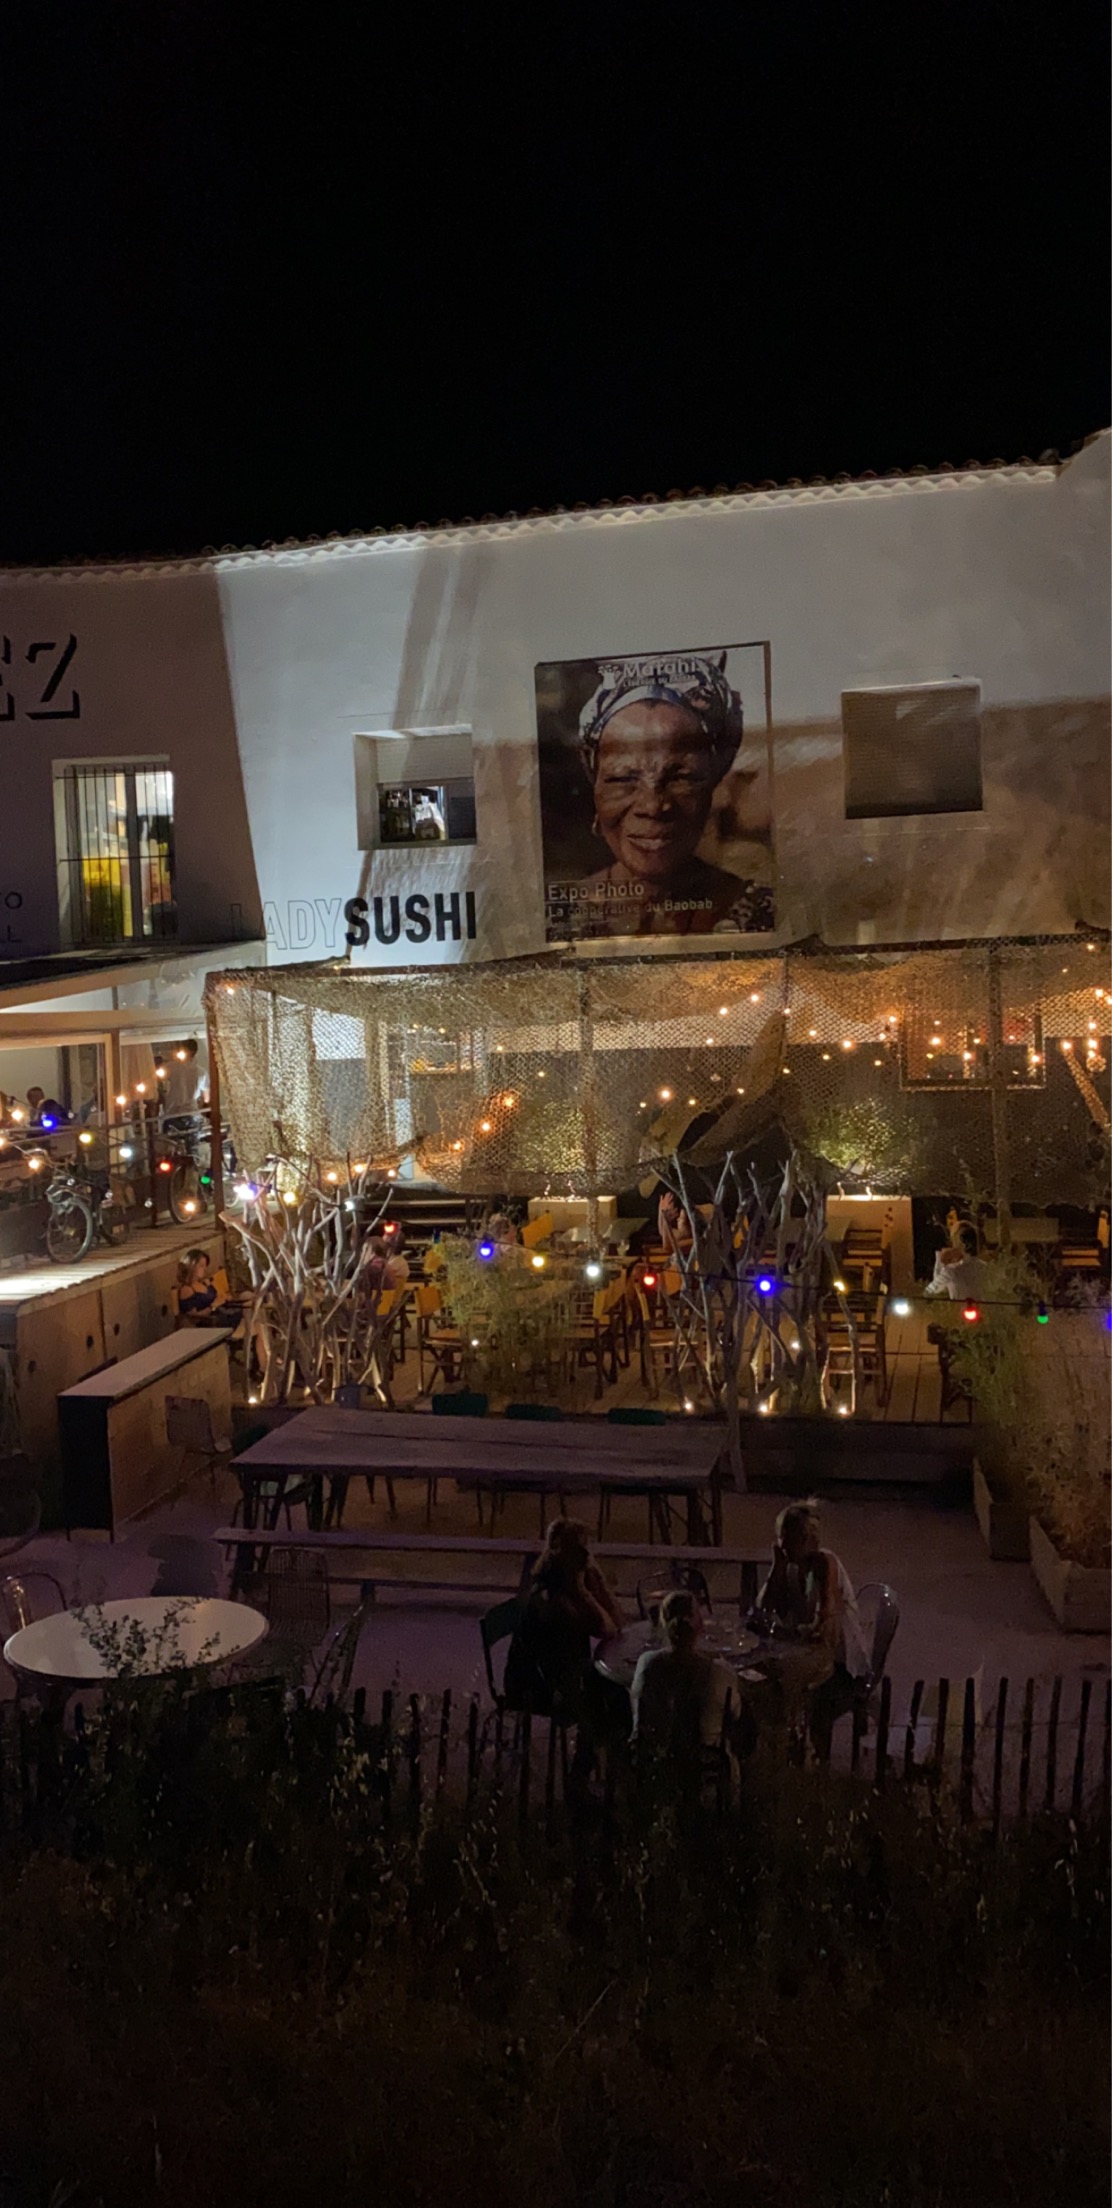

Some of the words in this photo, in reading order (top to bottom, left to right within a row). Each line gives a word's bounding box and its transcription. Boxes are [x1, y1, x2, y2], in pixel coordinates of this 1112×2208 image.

[548, 884, 589, 903] Expo
[595, 881, 645, 898] Photo
[548, 905, 564, 918] La
[645, 901, 660, 913] du
[664, 898, 713, 912] Baobab
